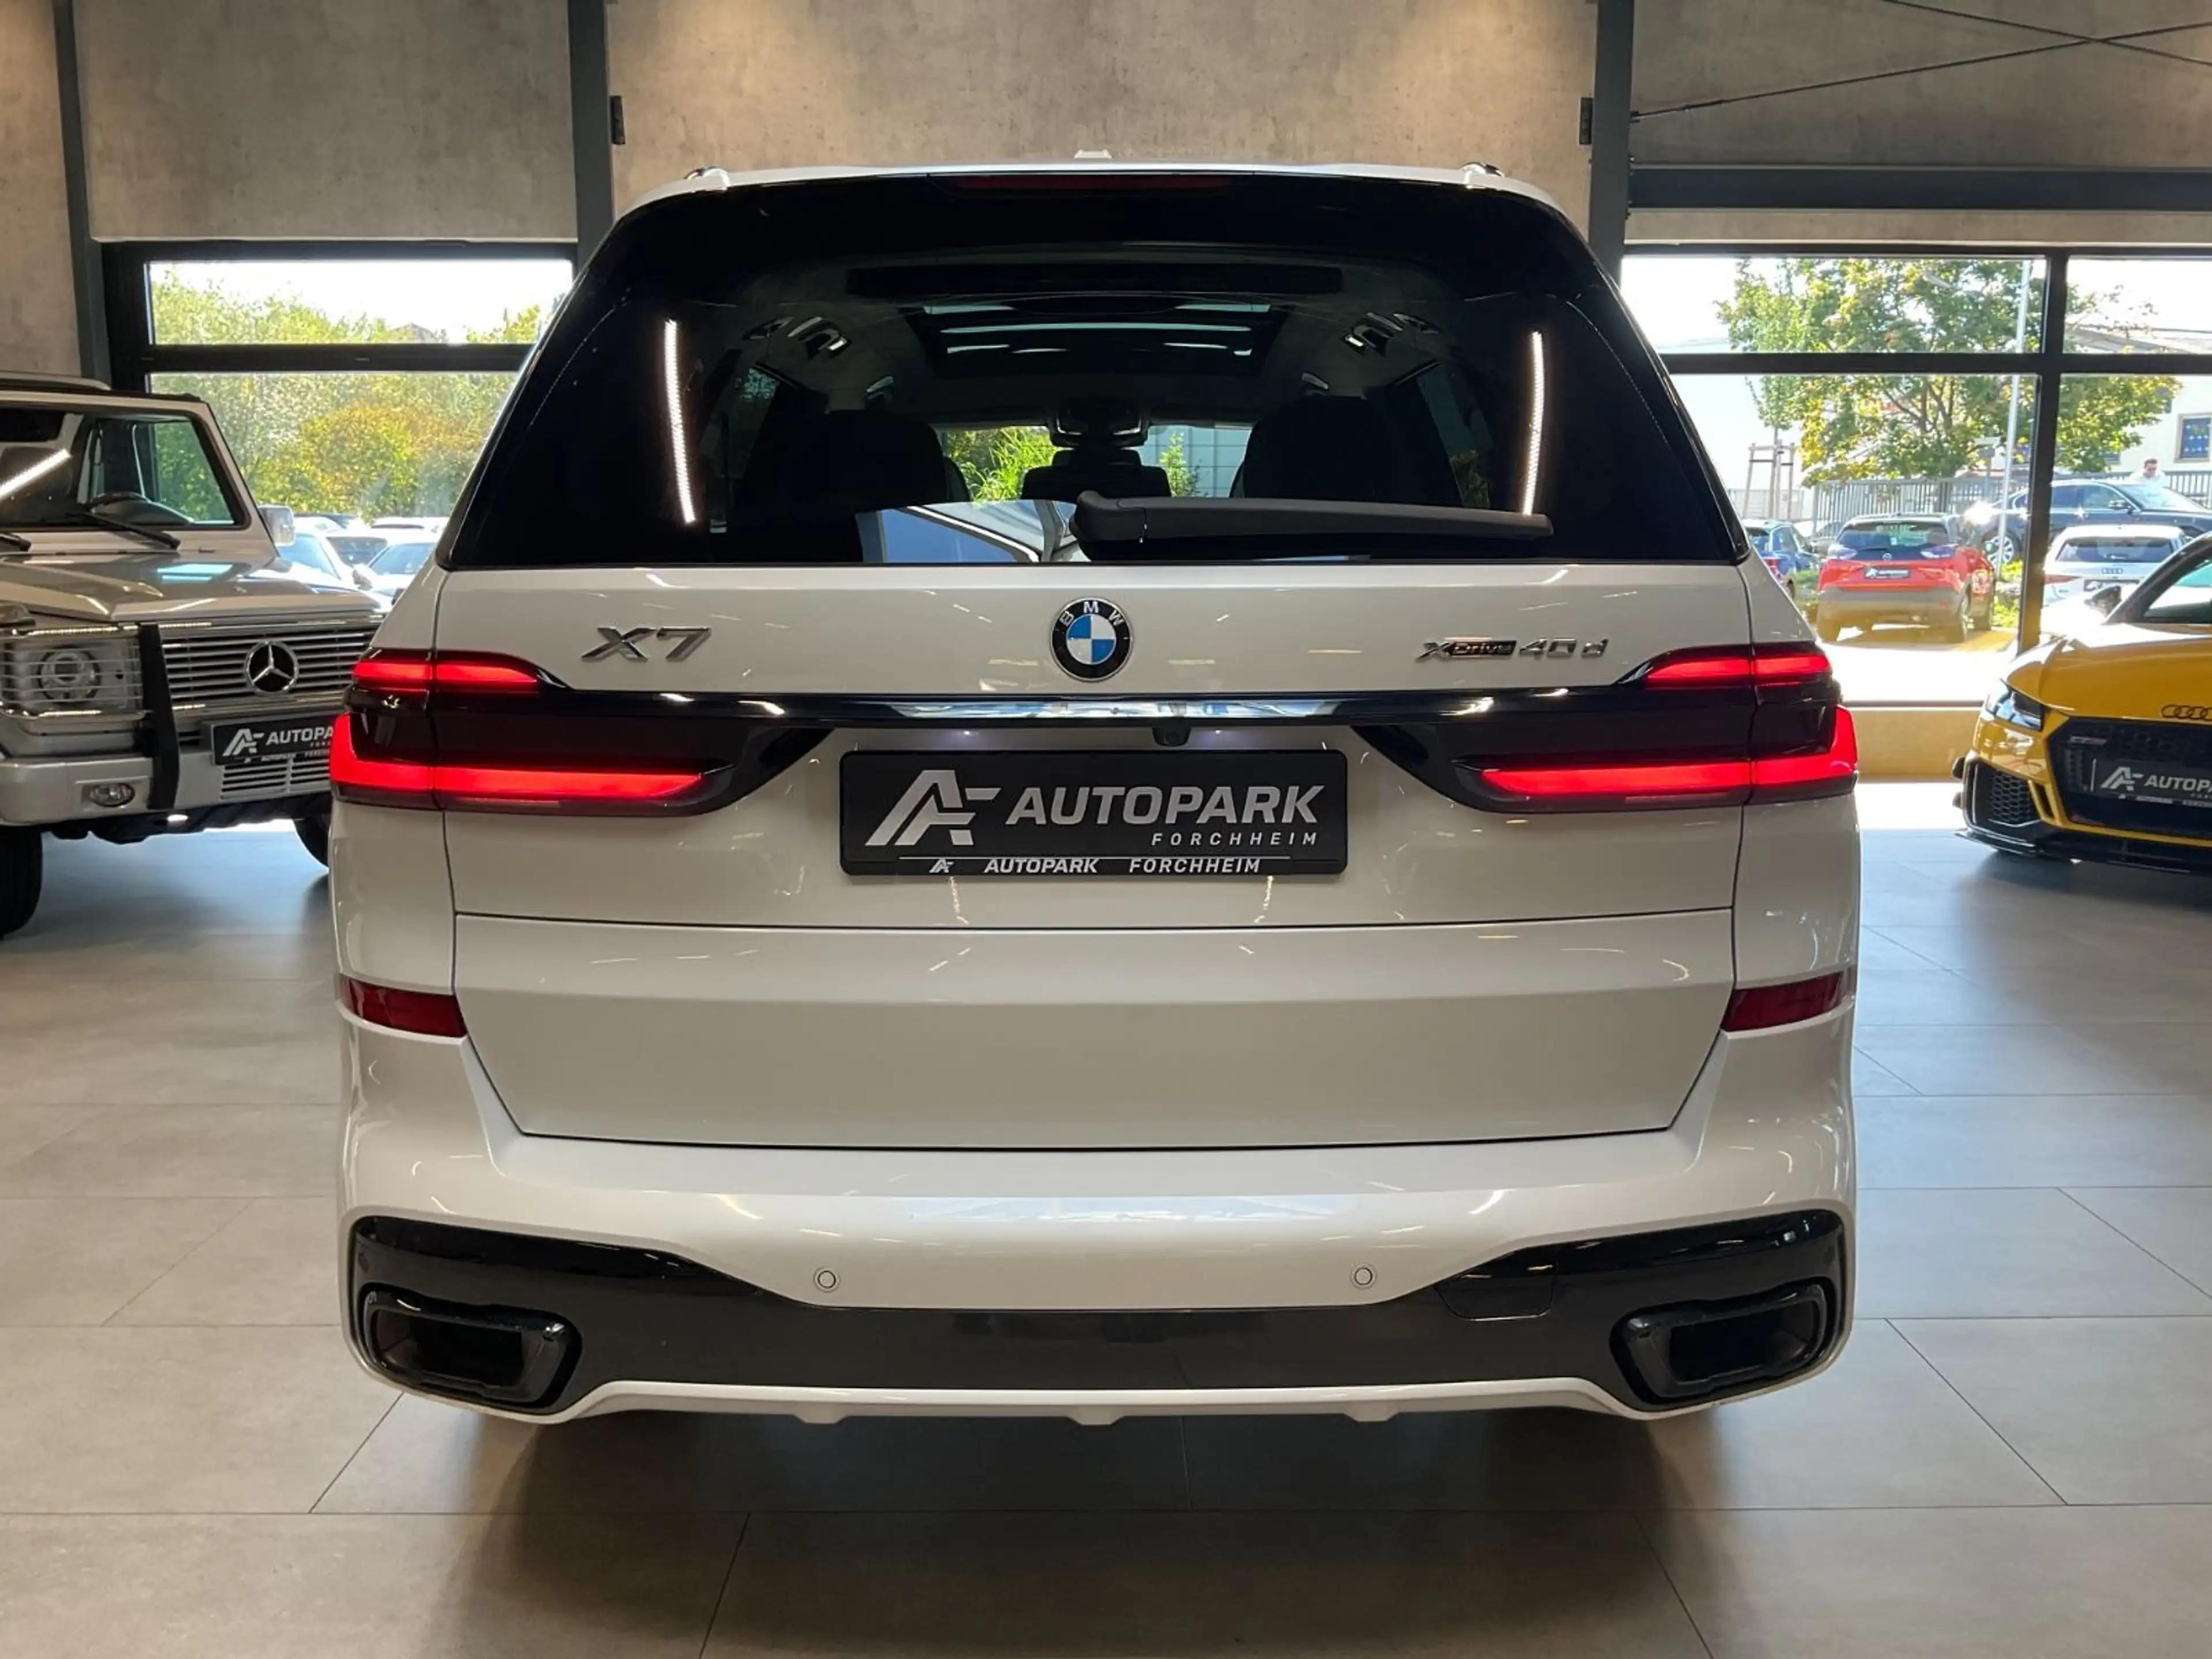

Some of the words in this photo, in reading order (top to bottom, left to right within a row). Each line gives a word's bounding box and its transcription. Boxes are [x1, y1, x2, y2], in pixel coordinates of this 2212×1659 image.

[1059, 601, 1125, 627] BMW
[581, 626, 711, 662] X7
[266, 726, 334, 746] AUTOPA
[2143, 775, 2212, 793] AUTOP
[1006, 785, 1324, 825] AUTOPARK
[1151, 832, 1317, 846] FORCHHEIM
[984, 858, 1099, 873] AUTOPARK
[1129, 858, 1260, 873] FORCHHEIM
